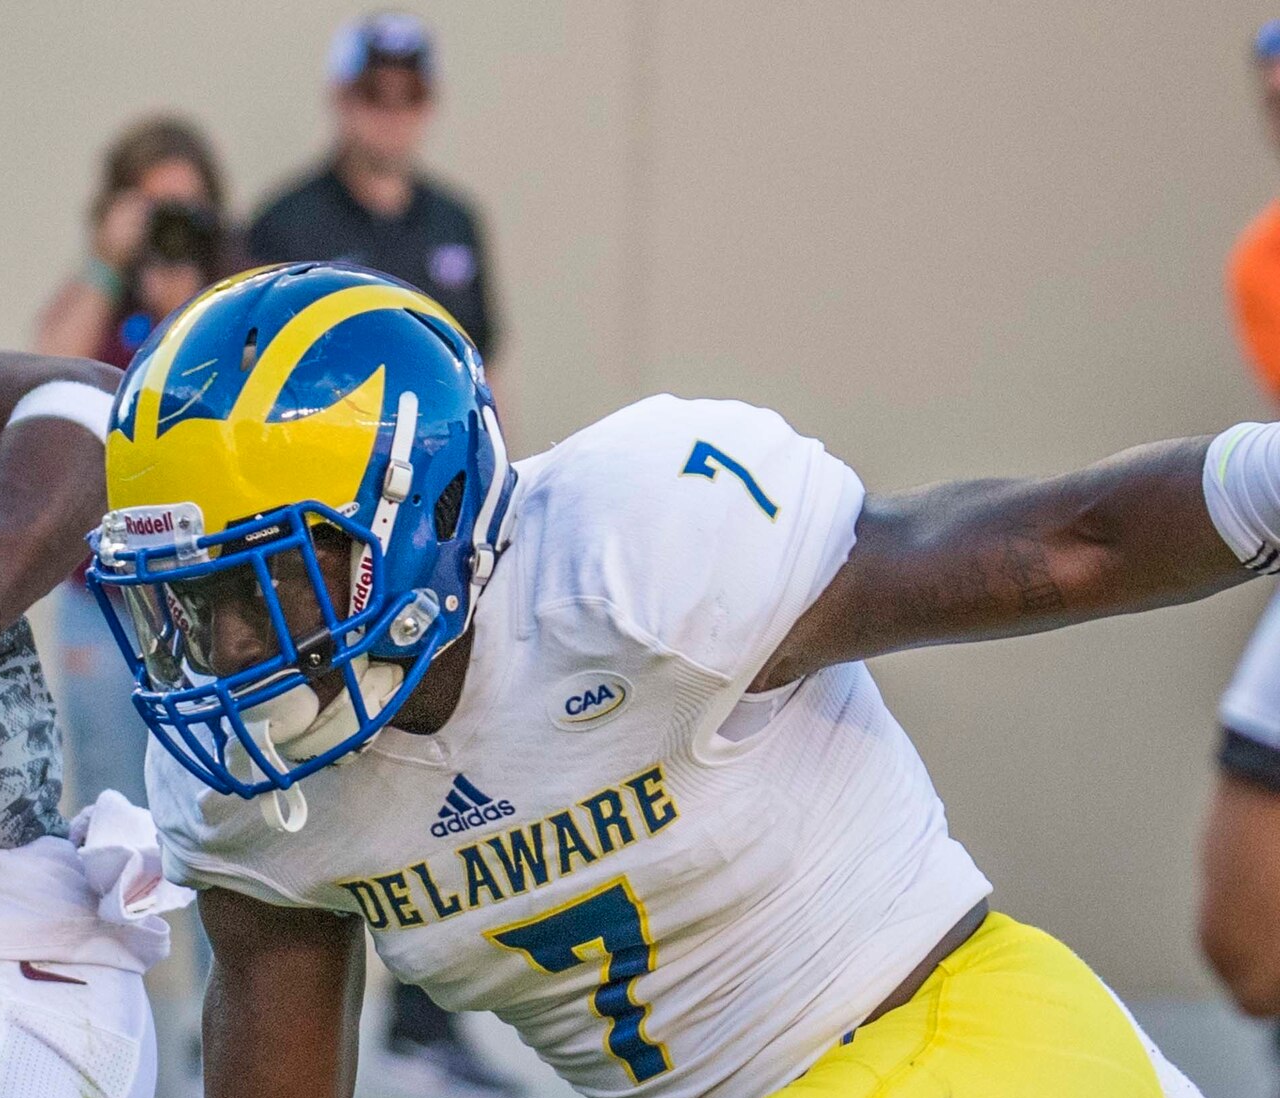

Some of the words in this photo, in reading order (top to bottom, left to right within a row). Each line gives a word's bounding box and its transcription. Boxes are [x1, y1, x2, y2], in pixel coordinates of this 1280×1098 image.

[678, 438, 780, 523] 7
[124, 511, 174, 536] Riddell
[565, 684, 616, 716] CAA
[344, 763, 681, 932] DELAWARE
[430, 799, 515, 838] adidas
[482, 873, 677, 1086] 7
